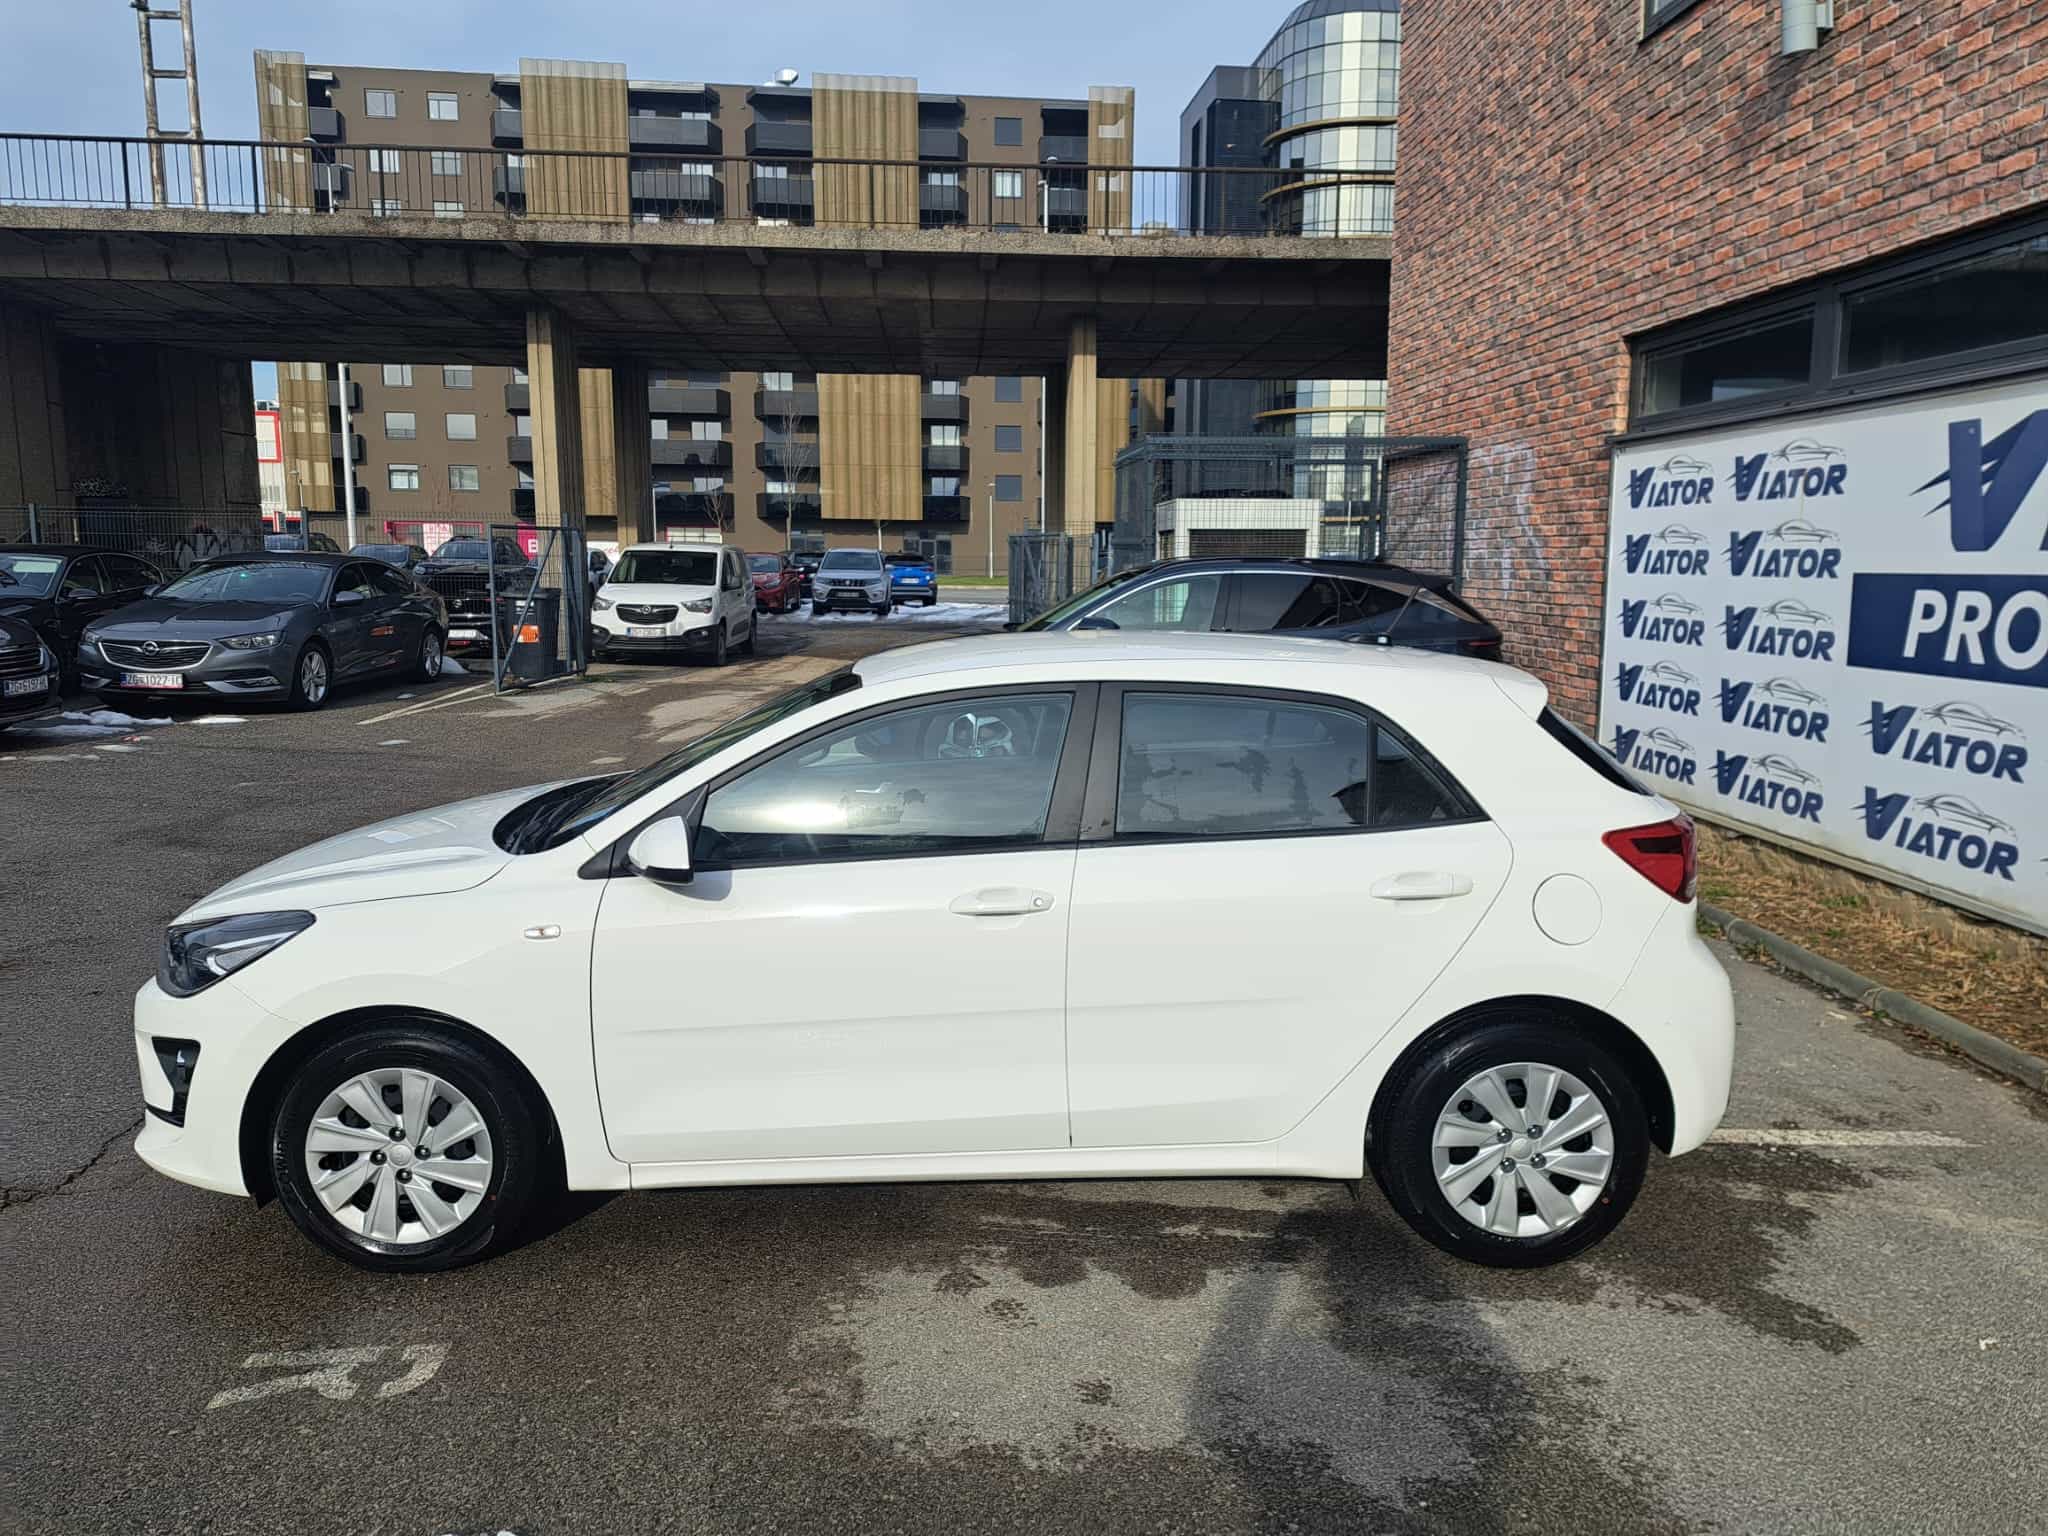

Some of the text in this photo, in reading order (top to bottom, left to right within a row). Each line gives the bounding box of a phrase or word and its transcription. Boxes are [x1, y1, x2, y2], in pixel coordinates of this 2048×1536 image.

[1626, 466, 1714, 509] VIATOR
[1730, 453, 1848, 502] VIATOR
[1908, 409, 2048, 552] V
[1621, 533, 1710, 576] VIATOR
[1725, 530, 1842, 579] VIATOR
[1618, 598, 1705, 647] VIATOR
[1718, 606, 1836, 662] VIATOR
[1903, 588, 2048, 671] PRO
[1613, 662, 1701, 717] VIATOR
[1714, 677, 1830, 743] VIATOR
[1614, 724, 1697, 784] VIATOR
[1861, 700, 2029, 784] VIATOR
[1711, 750, 1824, 823] VIATOR
[1856, 785, 2020, 881] VIATOR
